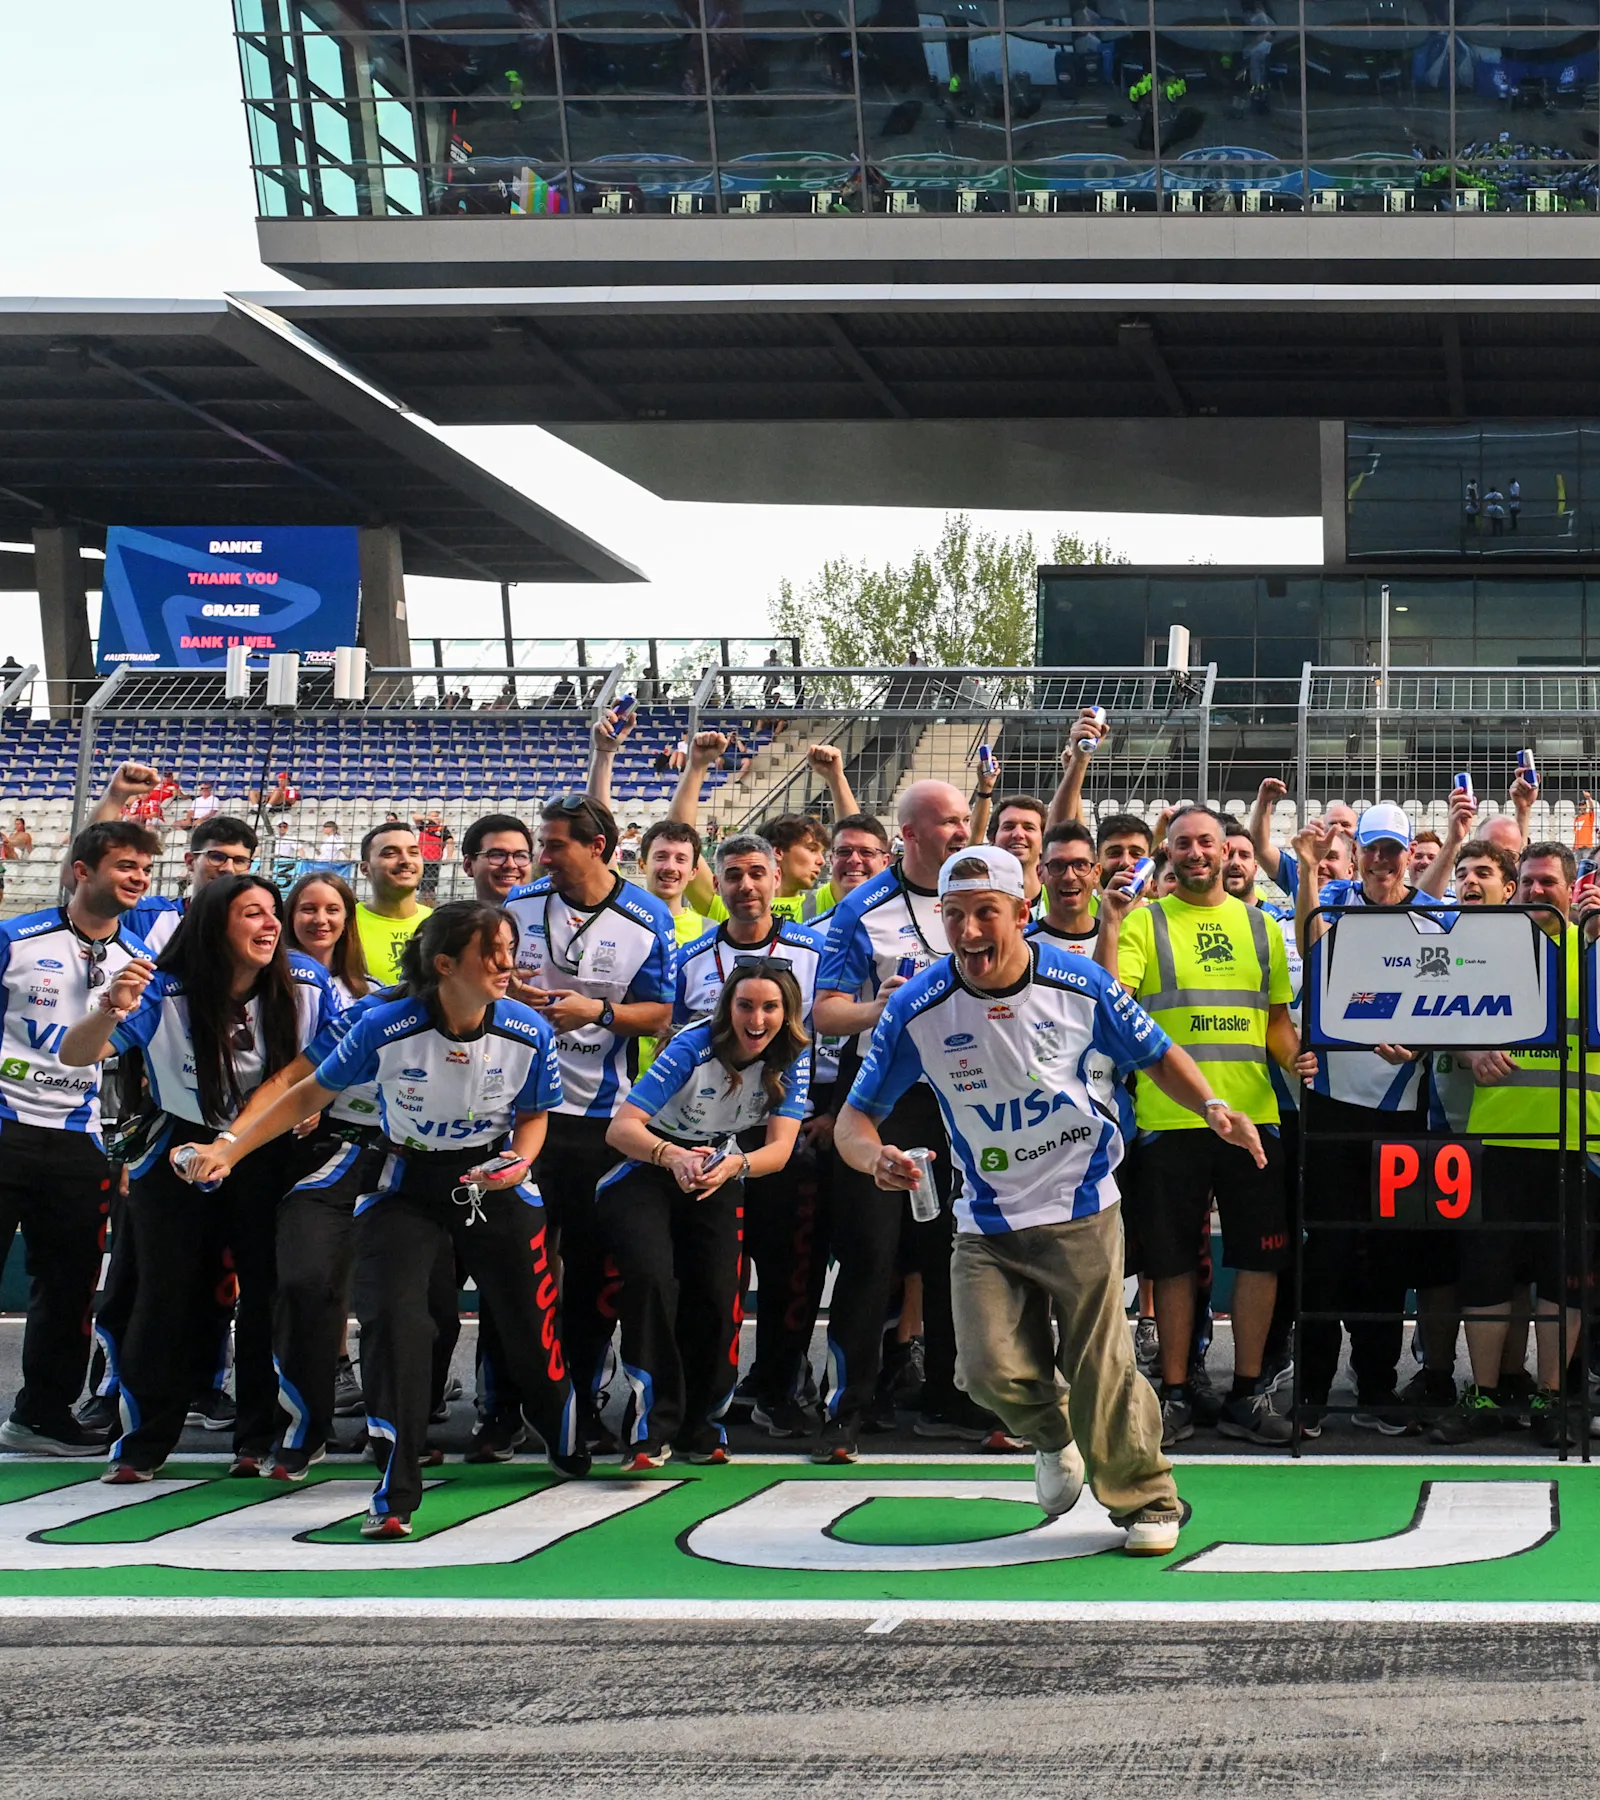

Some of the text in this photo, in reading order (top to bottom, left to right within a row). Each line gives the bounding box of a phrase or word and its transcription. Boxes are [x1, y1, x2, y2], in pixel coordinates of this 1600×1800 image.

[209, 541, 262, 553] DANKE
[188, 572, 278, 584] THANK YOU
[202, 604, 260, 617] GRAZIE
[180, 636, 276, 648] DANK U WEL
[104, 653, 160, 662] #AUSTRIANGP
[519, 882, 550, 896] HUGO
[863, 886, 889, 907] HUGO
[626, 901, 654, 923] HUGO
[17, 921, 53, 936] HUGO
[1196, 923, 1222, 931] VISA
[600, 940, 616, 948] VISA
[786, 932, 814, 944] HUGO
[125, 940, 152, 961] HUGO
[686, 937, 714, 955] HUGO
[521, 950, 543, 959] TUDOR
[1382, 957, 1411, 967] VISA
[1047, 967, 1087, 987] HUGO
[30, 986, 59, 995] TUDOR
[910, 979, 946, 1010] HUGO
[1107, 980, 1122, 998] VI
[28, 995, 57, 1008] Mobil
[1411, 995, 1512, 1016] LIAM
[1001, 1012, 1014, 1020] Bull
[1190, 1015, 1250, 1031] Airtasker
[383, 1016, 418, 1036] HUGO
[505, 1018, 538, 1037] HUGO
[1034, 1021, 1054, 1029] VISA
[20, 1016, 68, 1054] VI
[571, 1041, 601, 1054] App
[699, 1046, 710, 1058] HU
[818, 1047, 840, 1058] Cas
[949, 1067, 983, 1079] TUDOR
[33, 1070, 93, 1092] Cash App
[954, 1080, 987, 1092] Mobil
[398, 1090, 424, 1102] TUDOR
[396, 1097, 422, 1112] Mobil
[966, 1088, 1078, 1132] VISA
[680, 1108, 701, 1124] Mobil
[409, 1117, 493, 1139] VISA
[1015, 1124, 1092, 1162] Cash App
[1378, 1143, 1473, 1219] P9
[529, 1223, 565, 1382] HUGO
